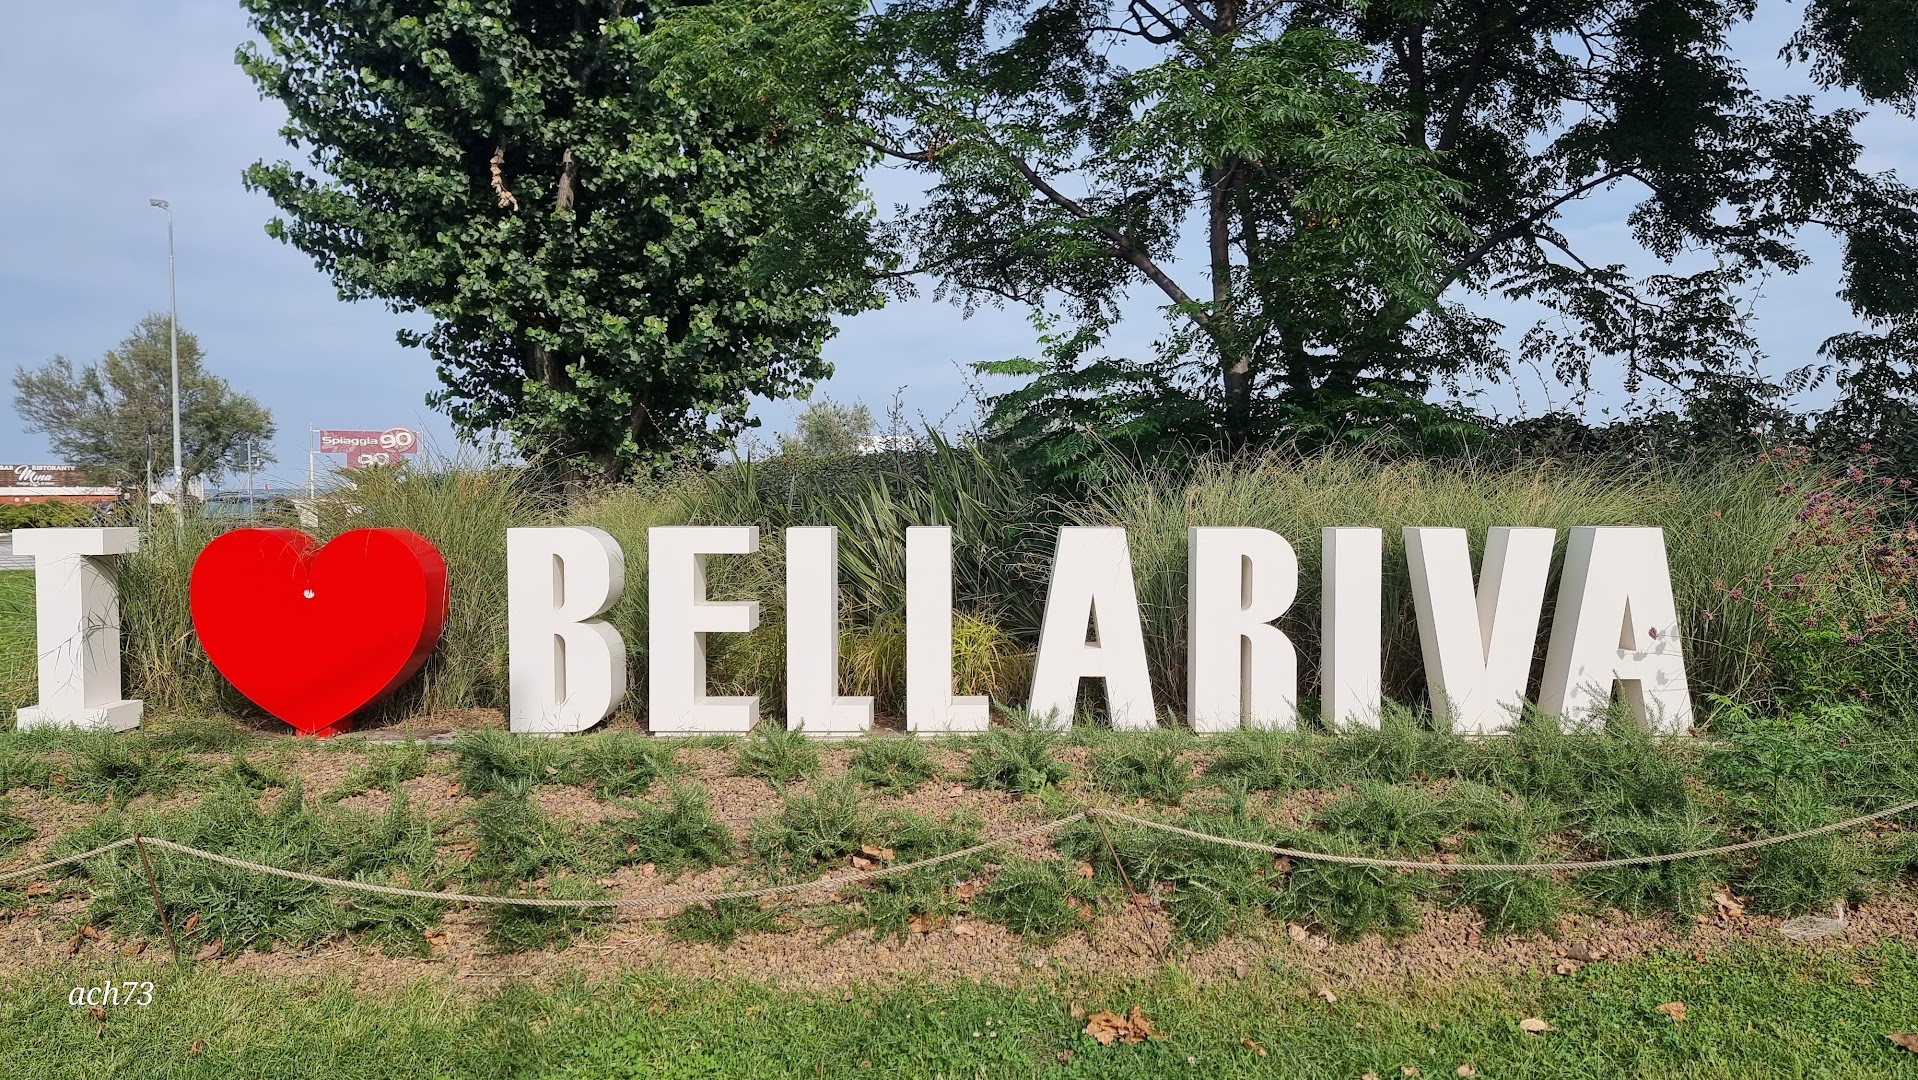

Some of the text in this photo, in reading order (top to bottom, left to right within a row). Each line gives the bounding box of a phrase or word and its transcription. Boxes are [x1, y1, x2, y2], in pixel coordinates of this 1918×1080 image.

[321, 432, 412, 449] Spiaggia 90
[14, 465, 54, 486] Mina
[12, 526, 1694, 736] I BELLARIVA
